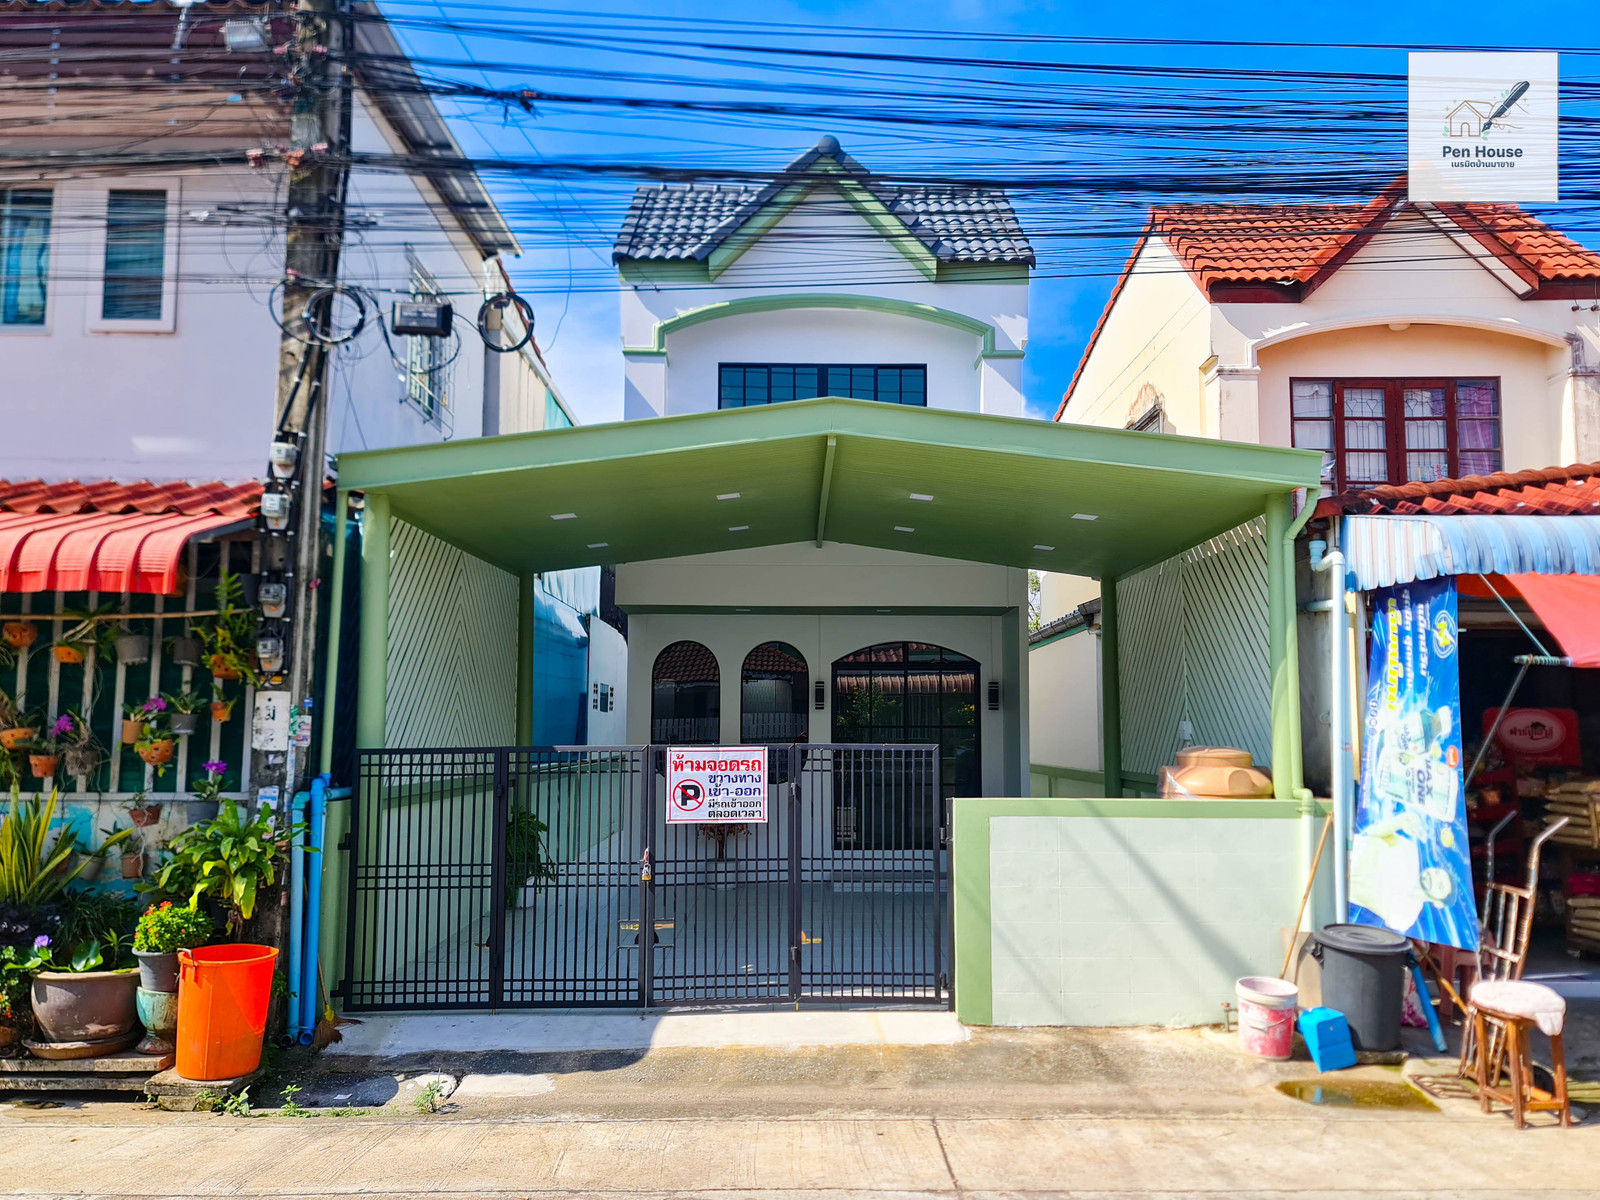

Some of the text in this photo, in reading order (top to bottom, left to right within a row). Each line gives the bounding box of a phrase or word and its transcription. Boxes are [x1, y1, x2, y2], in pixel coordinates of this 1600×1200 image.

[672, 754, 762, 772] ห้ามจอดรถ
[708, 774, 762, 784] ขวางทาง
[1425, 758, 1434, 799] MAX
[708, 783, 761, 797] เข้า-ออก
[1416, 769, 1426, 806] ONE
[708, 799, 762, 808] มีรถเข้าออก
[708, 810, 762, 818] ตลอดเวลา
